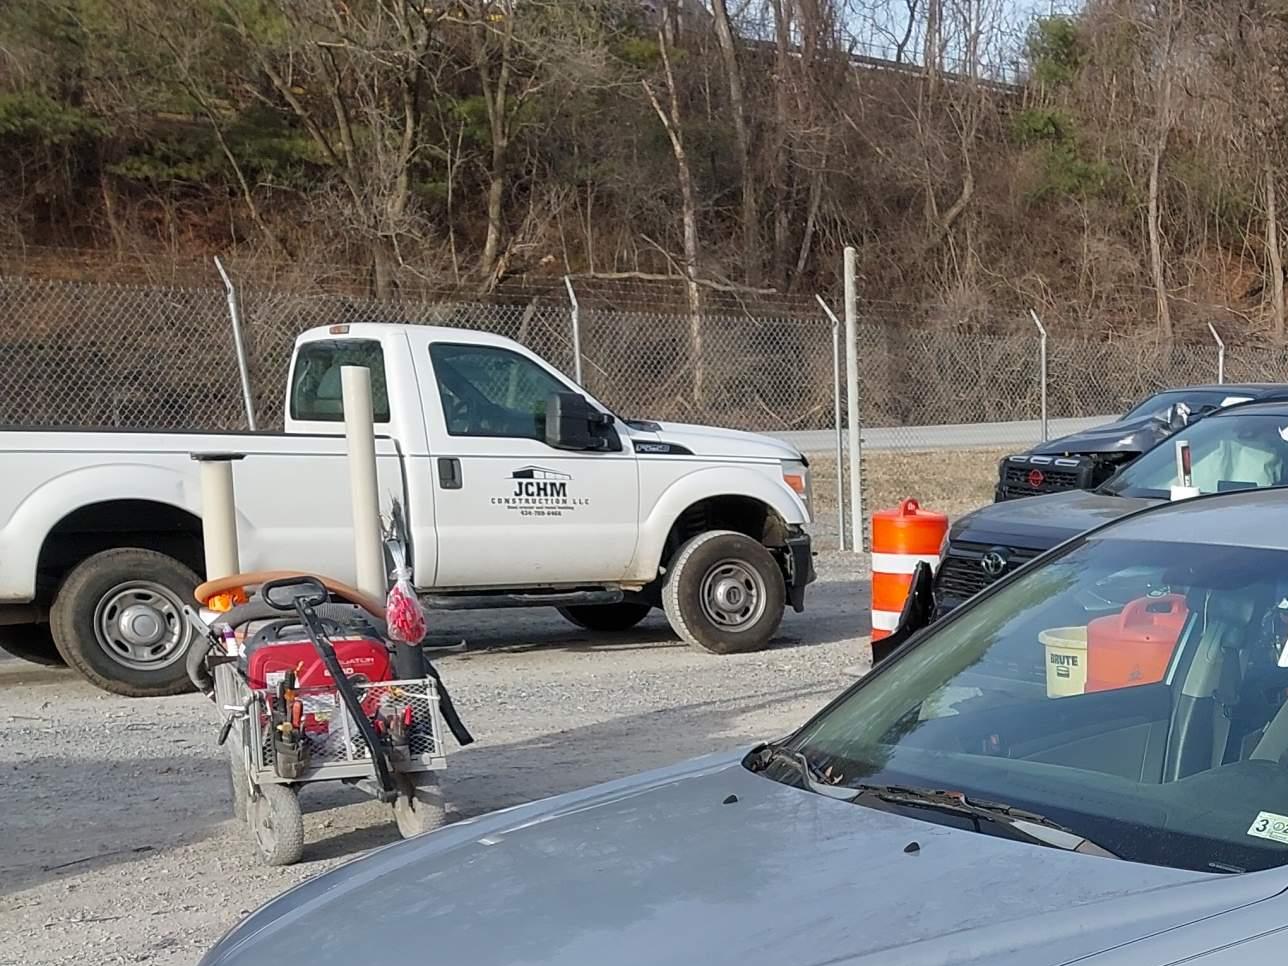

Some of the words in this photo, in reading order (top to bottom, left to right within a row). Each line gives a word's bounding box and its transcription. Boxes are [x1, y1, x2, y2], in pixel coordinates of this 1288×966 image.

[514, 481, 567, 497] JCHM
[1050, 653, 1078, 666] BRUTE
[1256, 819, 1269, 832] 3
